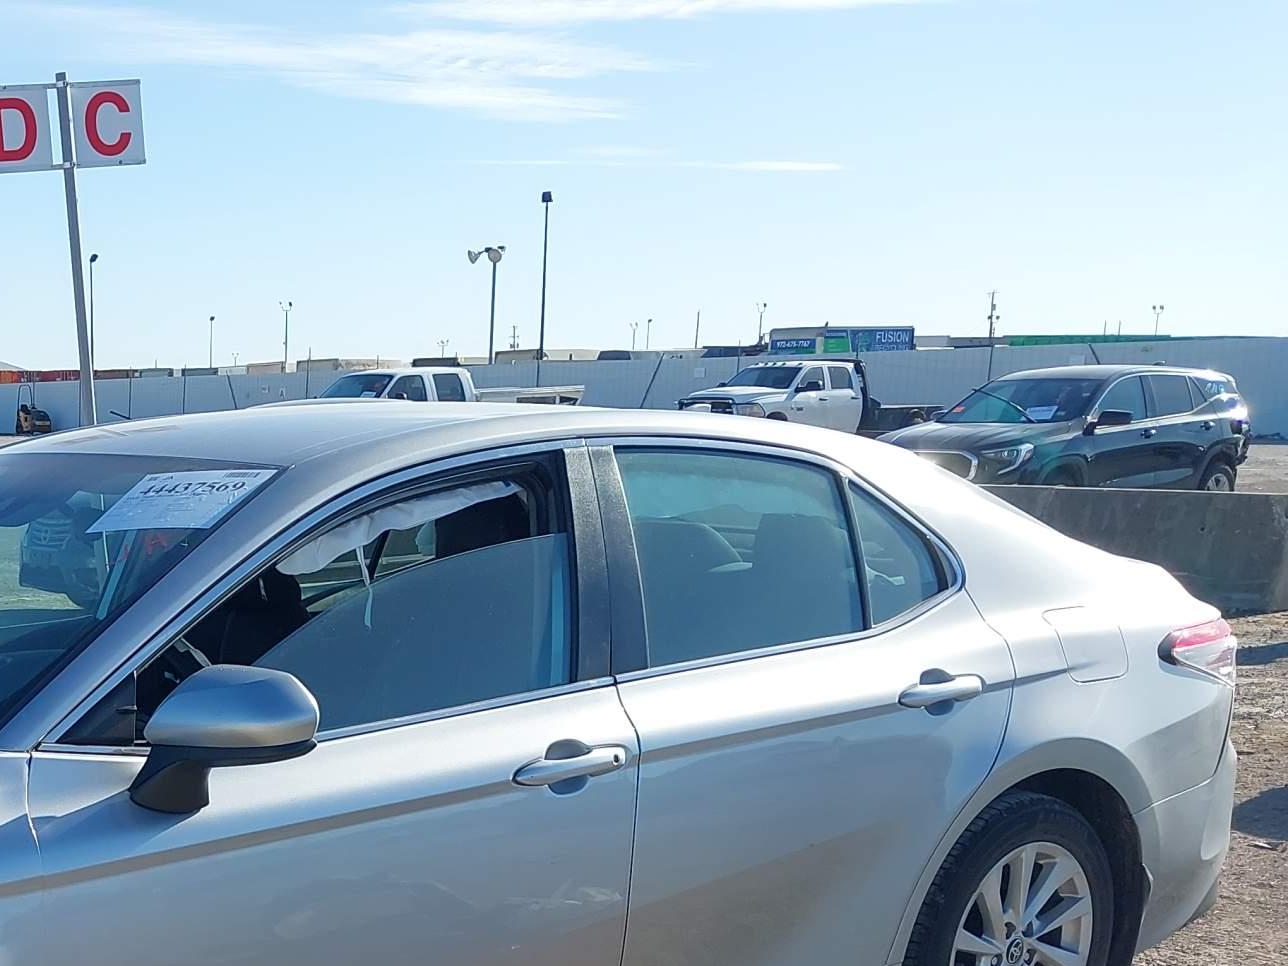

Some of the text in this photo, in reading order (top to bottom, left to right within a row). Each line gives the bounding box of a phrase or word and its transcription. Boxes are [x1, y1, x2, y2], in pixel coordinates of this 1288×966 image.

[84, 91, 132, 156] C
[875, 331, 910, 343] FUSION
[139, 481, 247, 496] 44437569
